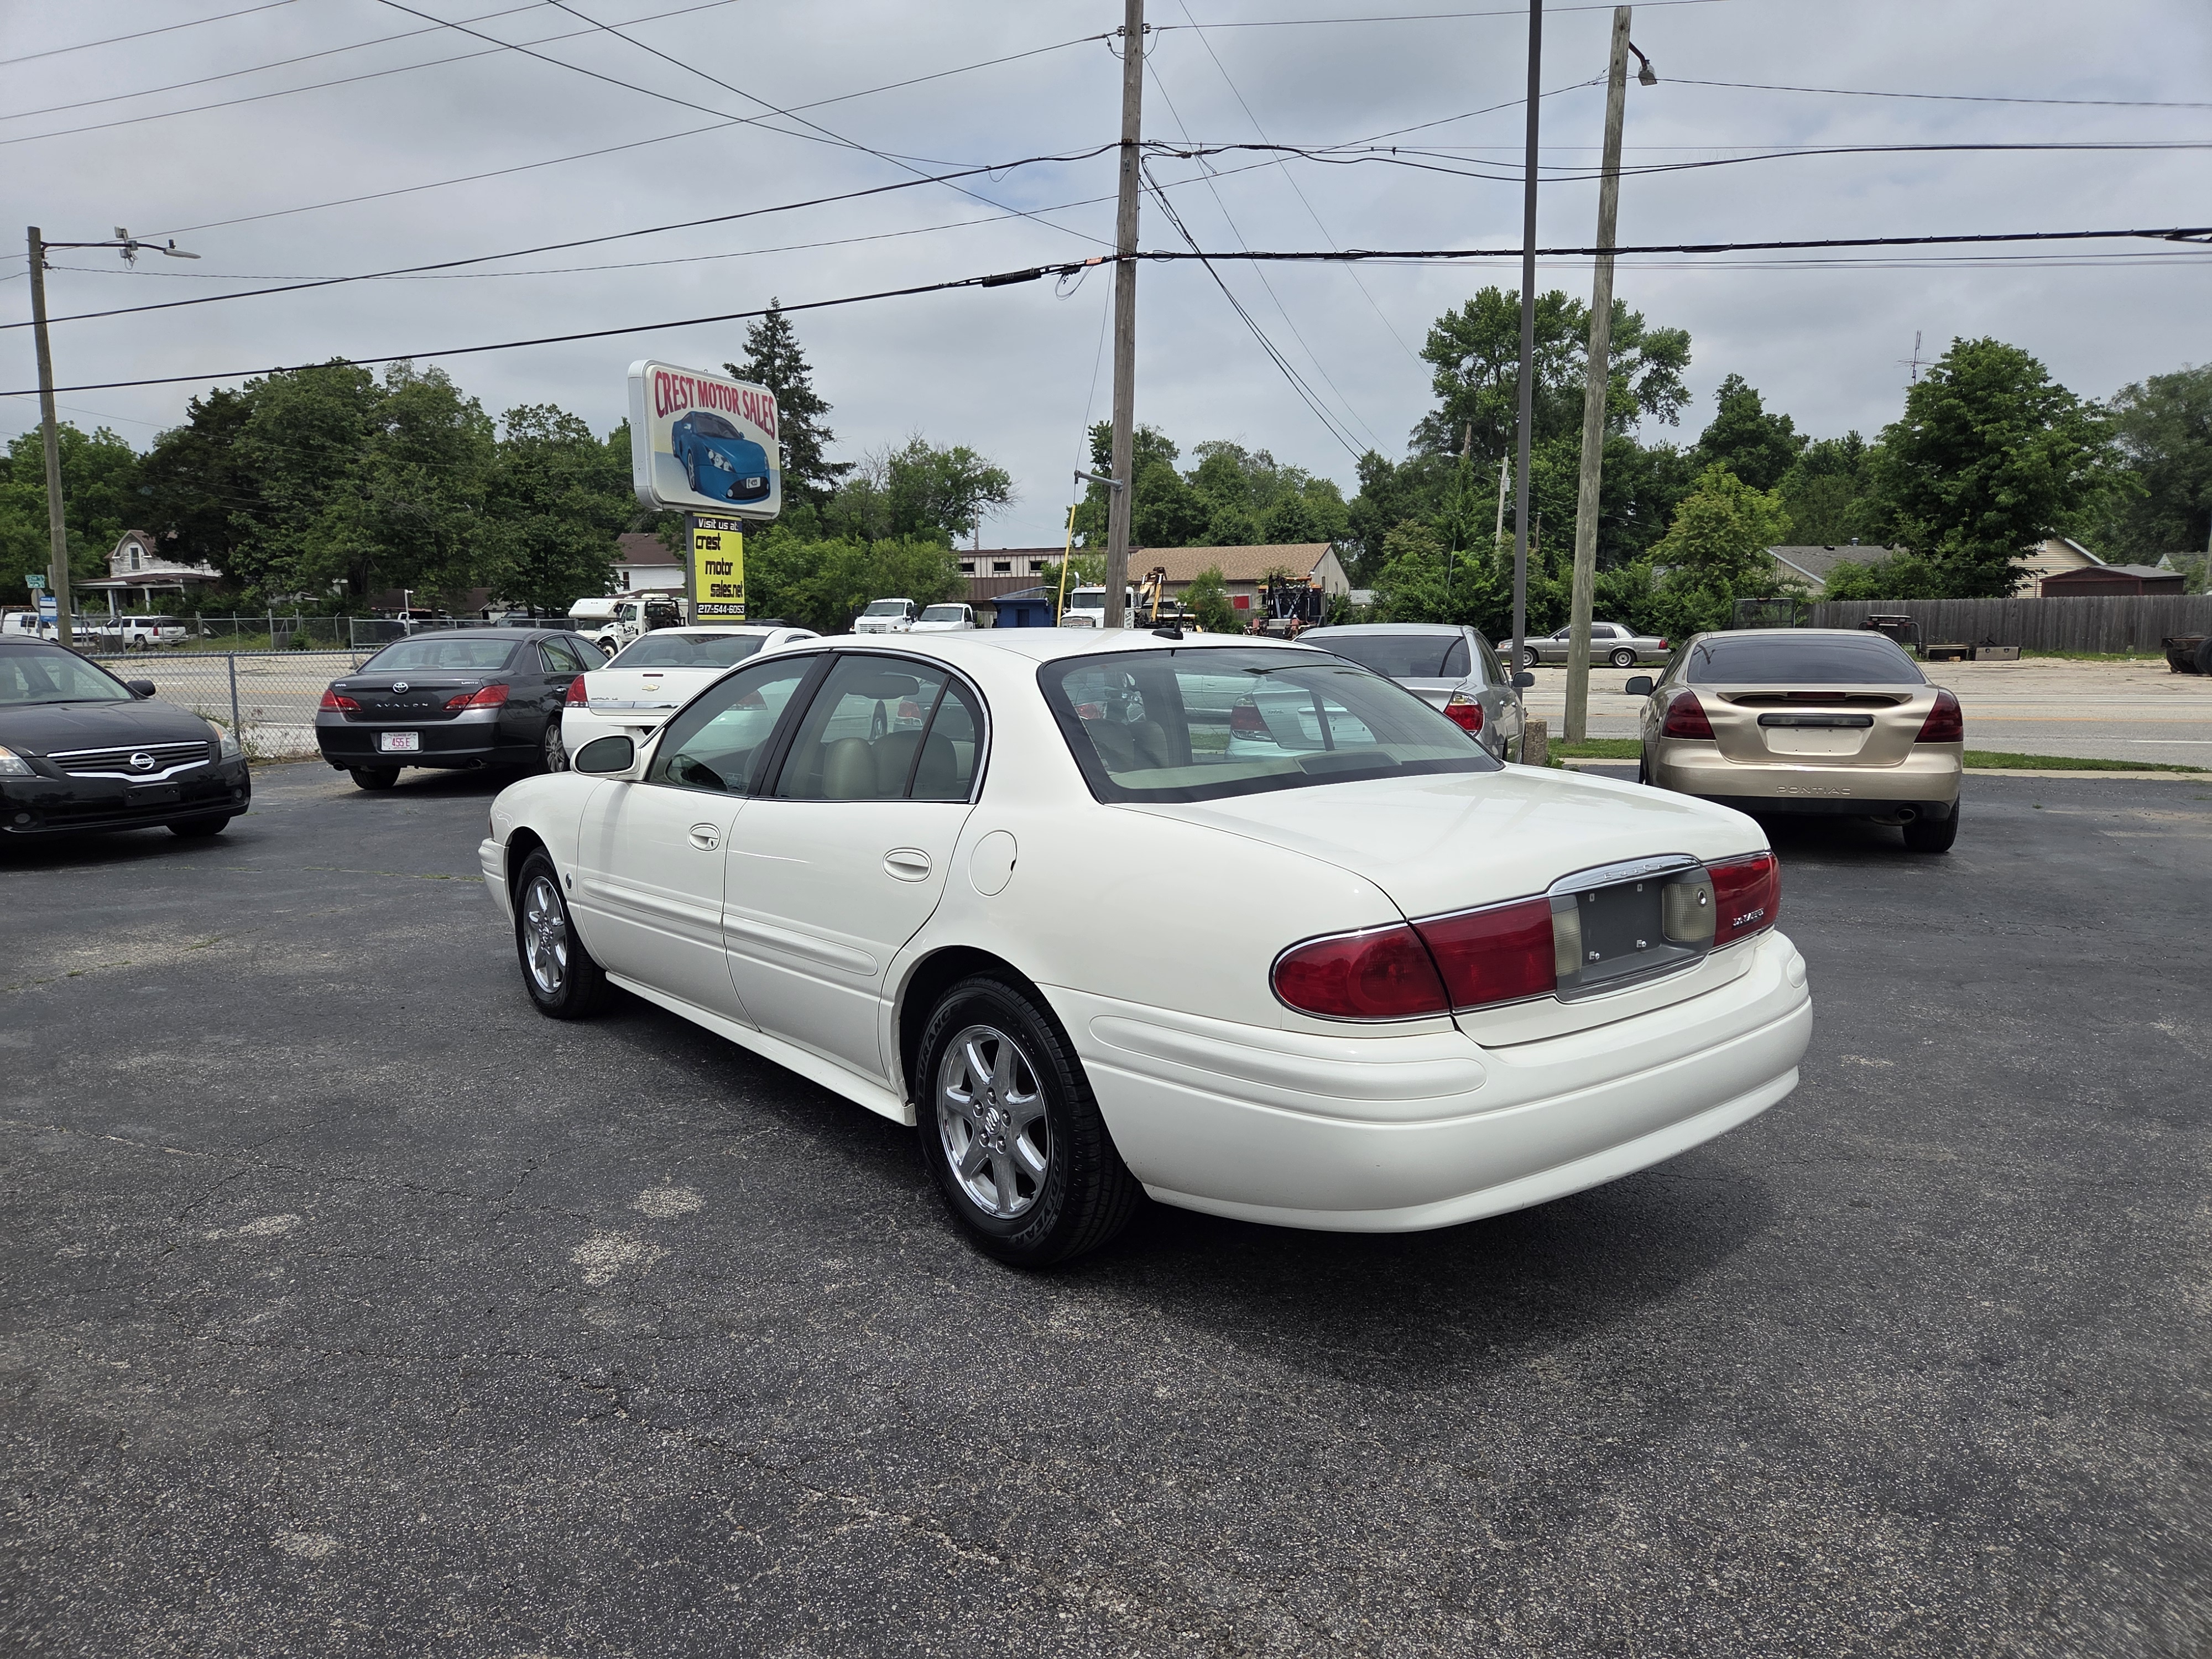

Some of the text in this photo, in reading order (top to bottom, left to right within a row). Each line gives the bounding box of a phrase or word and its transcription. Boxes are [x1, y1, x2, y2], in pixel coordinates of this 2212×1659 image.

[655, 370, 775, 441] CREST MOTOR SALES
[698, 518, 717, 529] Visit
[718, 521, 729, 530] us
[695, 532, 721, 551] crest
[705, 557, 733, 576] motor
[710, 579, 743, 598] sales.net
[698, 604, 745, 614] 217-544-6053
[392, 737, 404, 747] 455
[1776, 786, 1851, 795] PONTIAC
